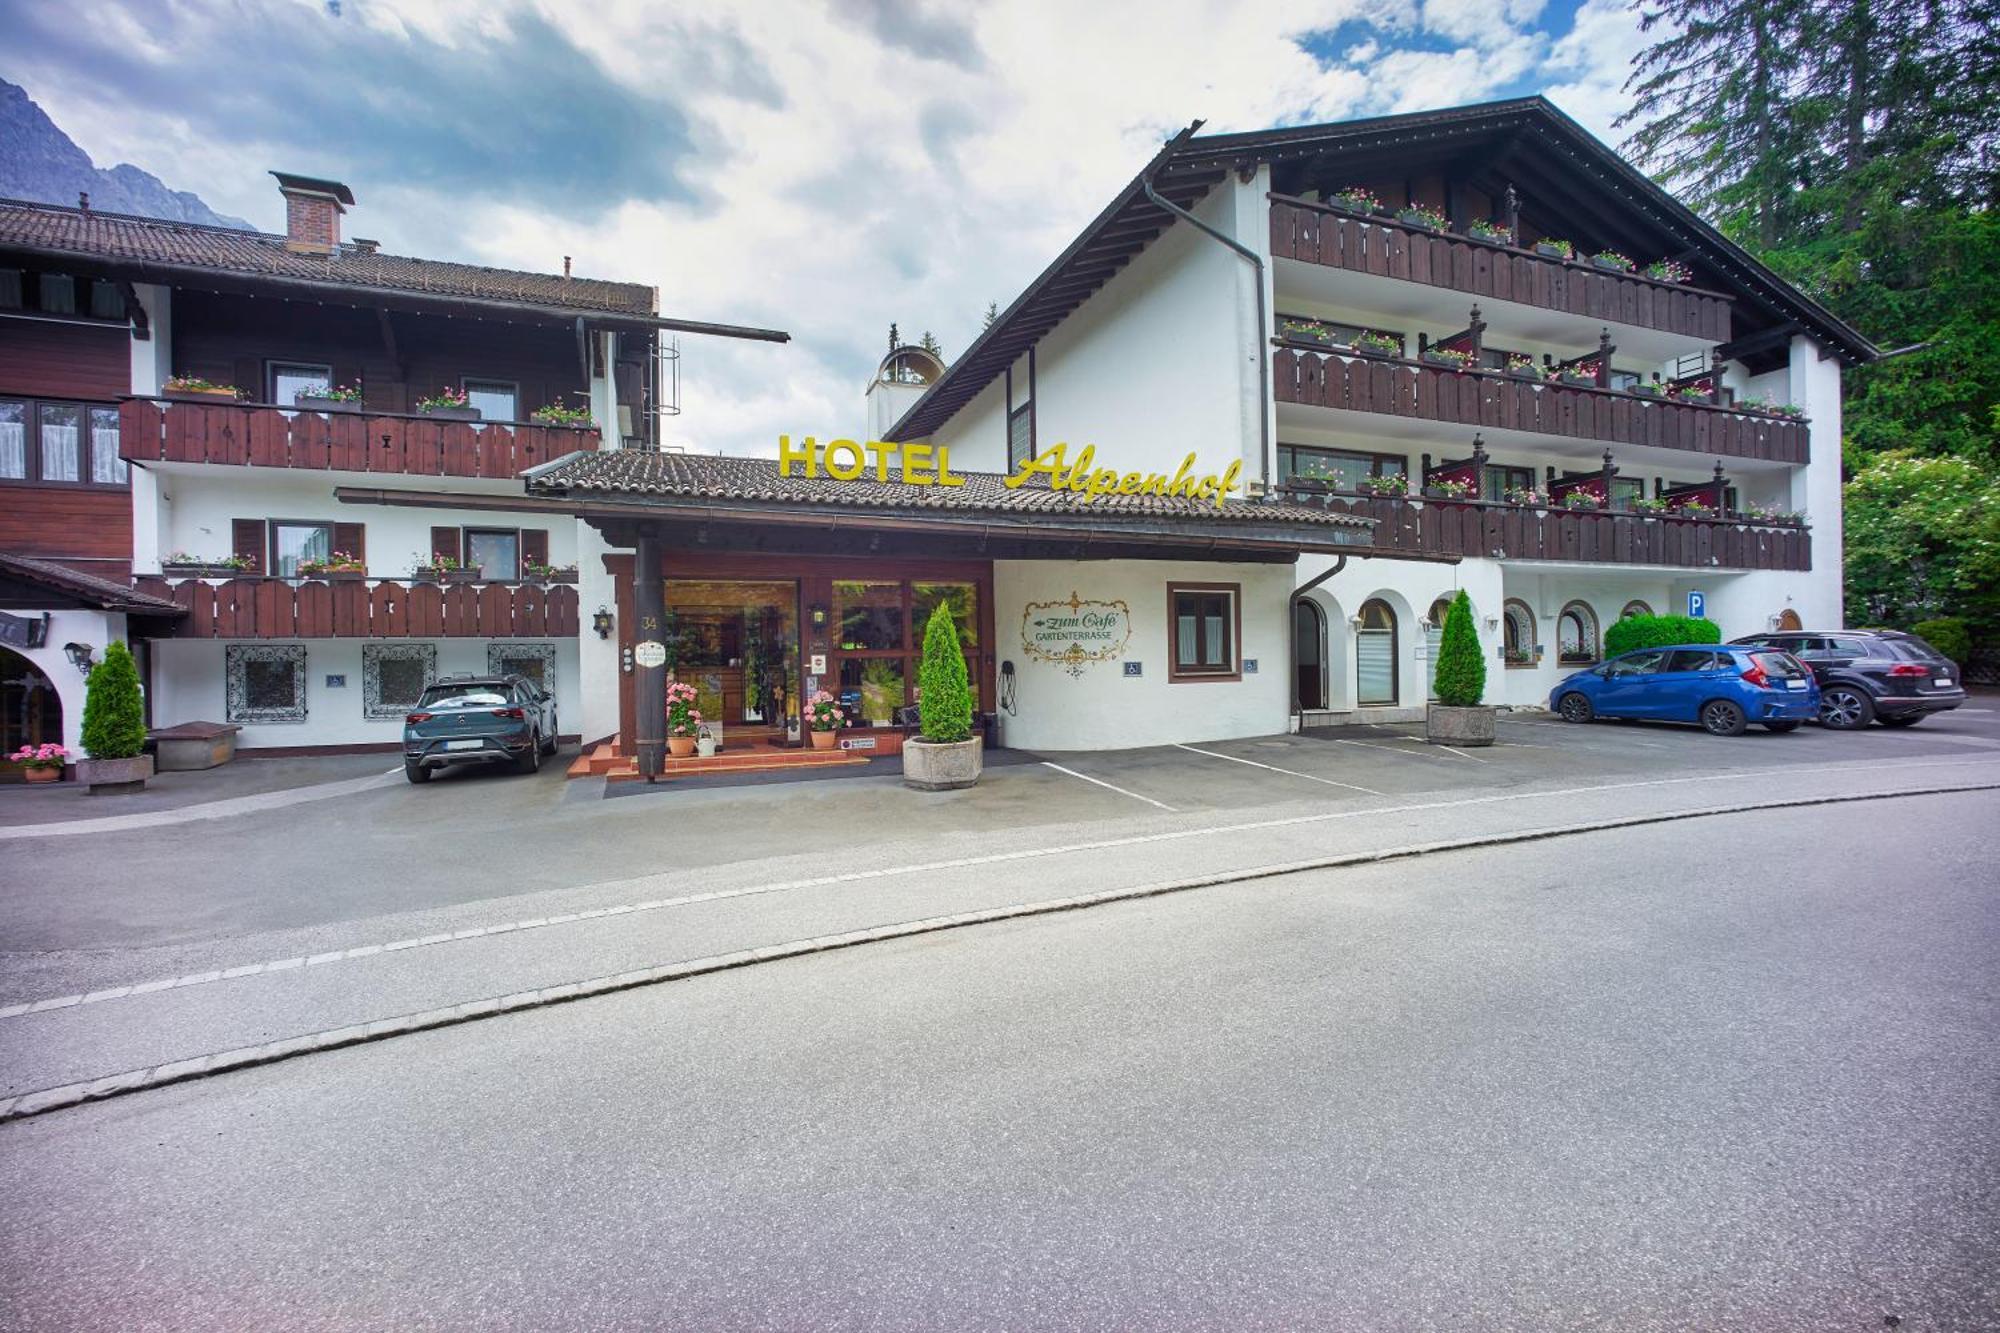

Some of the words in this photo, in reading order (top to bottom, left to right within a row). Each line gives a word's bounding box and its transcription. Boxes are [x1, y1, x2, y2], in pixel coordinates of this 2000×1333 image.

[779, 435, 966, 486] HOTEL
[1003, 442, 1243, 509] Alpenhof
[1691, 595, 1702, 615] P
[641, 616, 657, 630] 34
[1082, 612, 1120, 631] Café
[1035, 631, 1112, 641] GARTENTERRASSE
